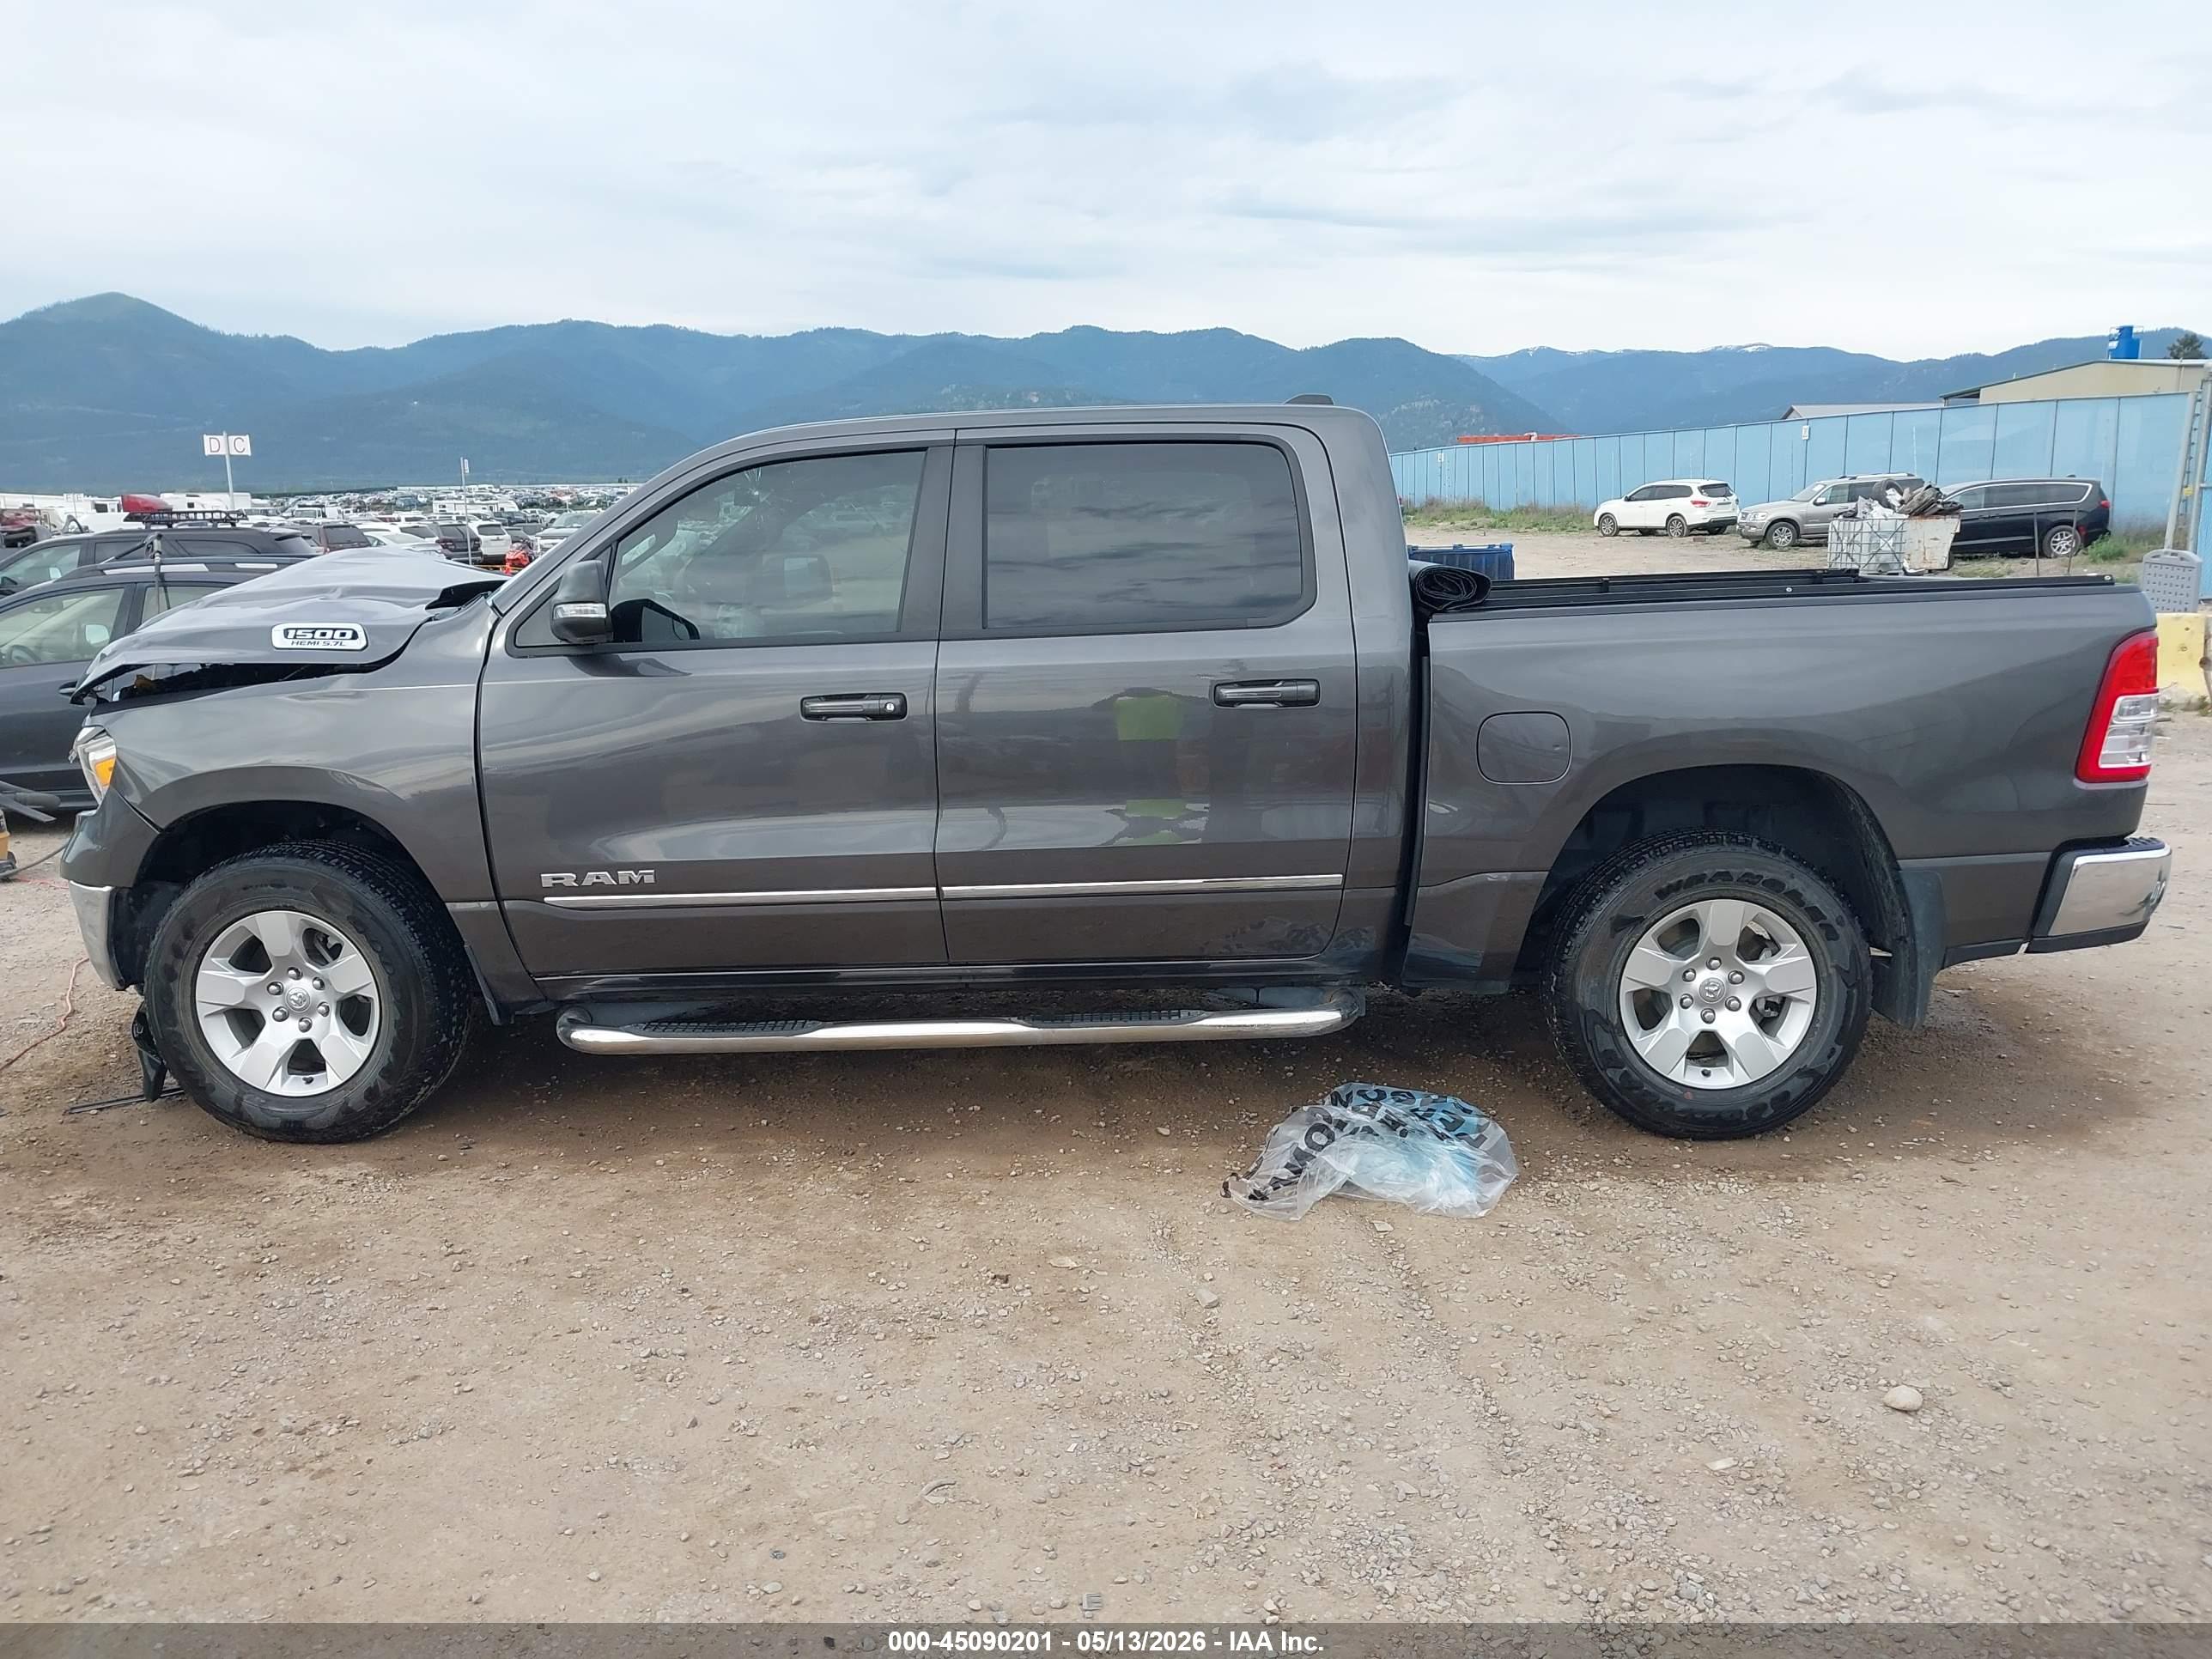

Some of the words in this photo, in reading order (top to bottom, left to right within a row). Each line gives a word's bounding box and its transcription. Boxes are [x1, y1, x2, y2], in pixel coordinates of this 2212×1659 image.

[209, 437, 221, 453] D
[234, 437, 246, 453] C
[286, 629, 354, 640] 1500
[540, 869, 655, 887] RAM
